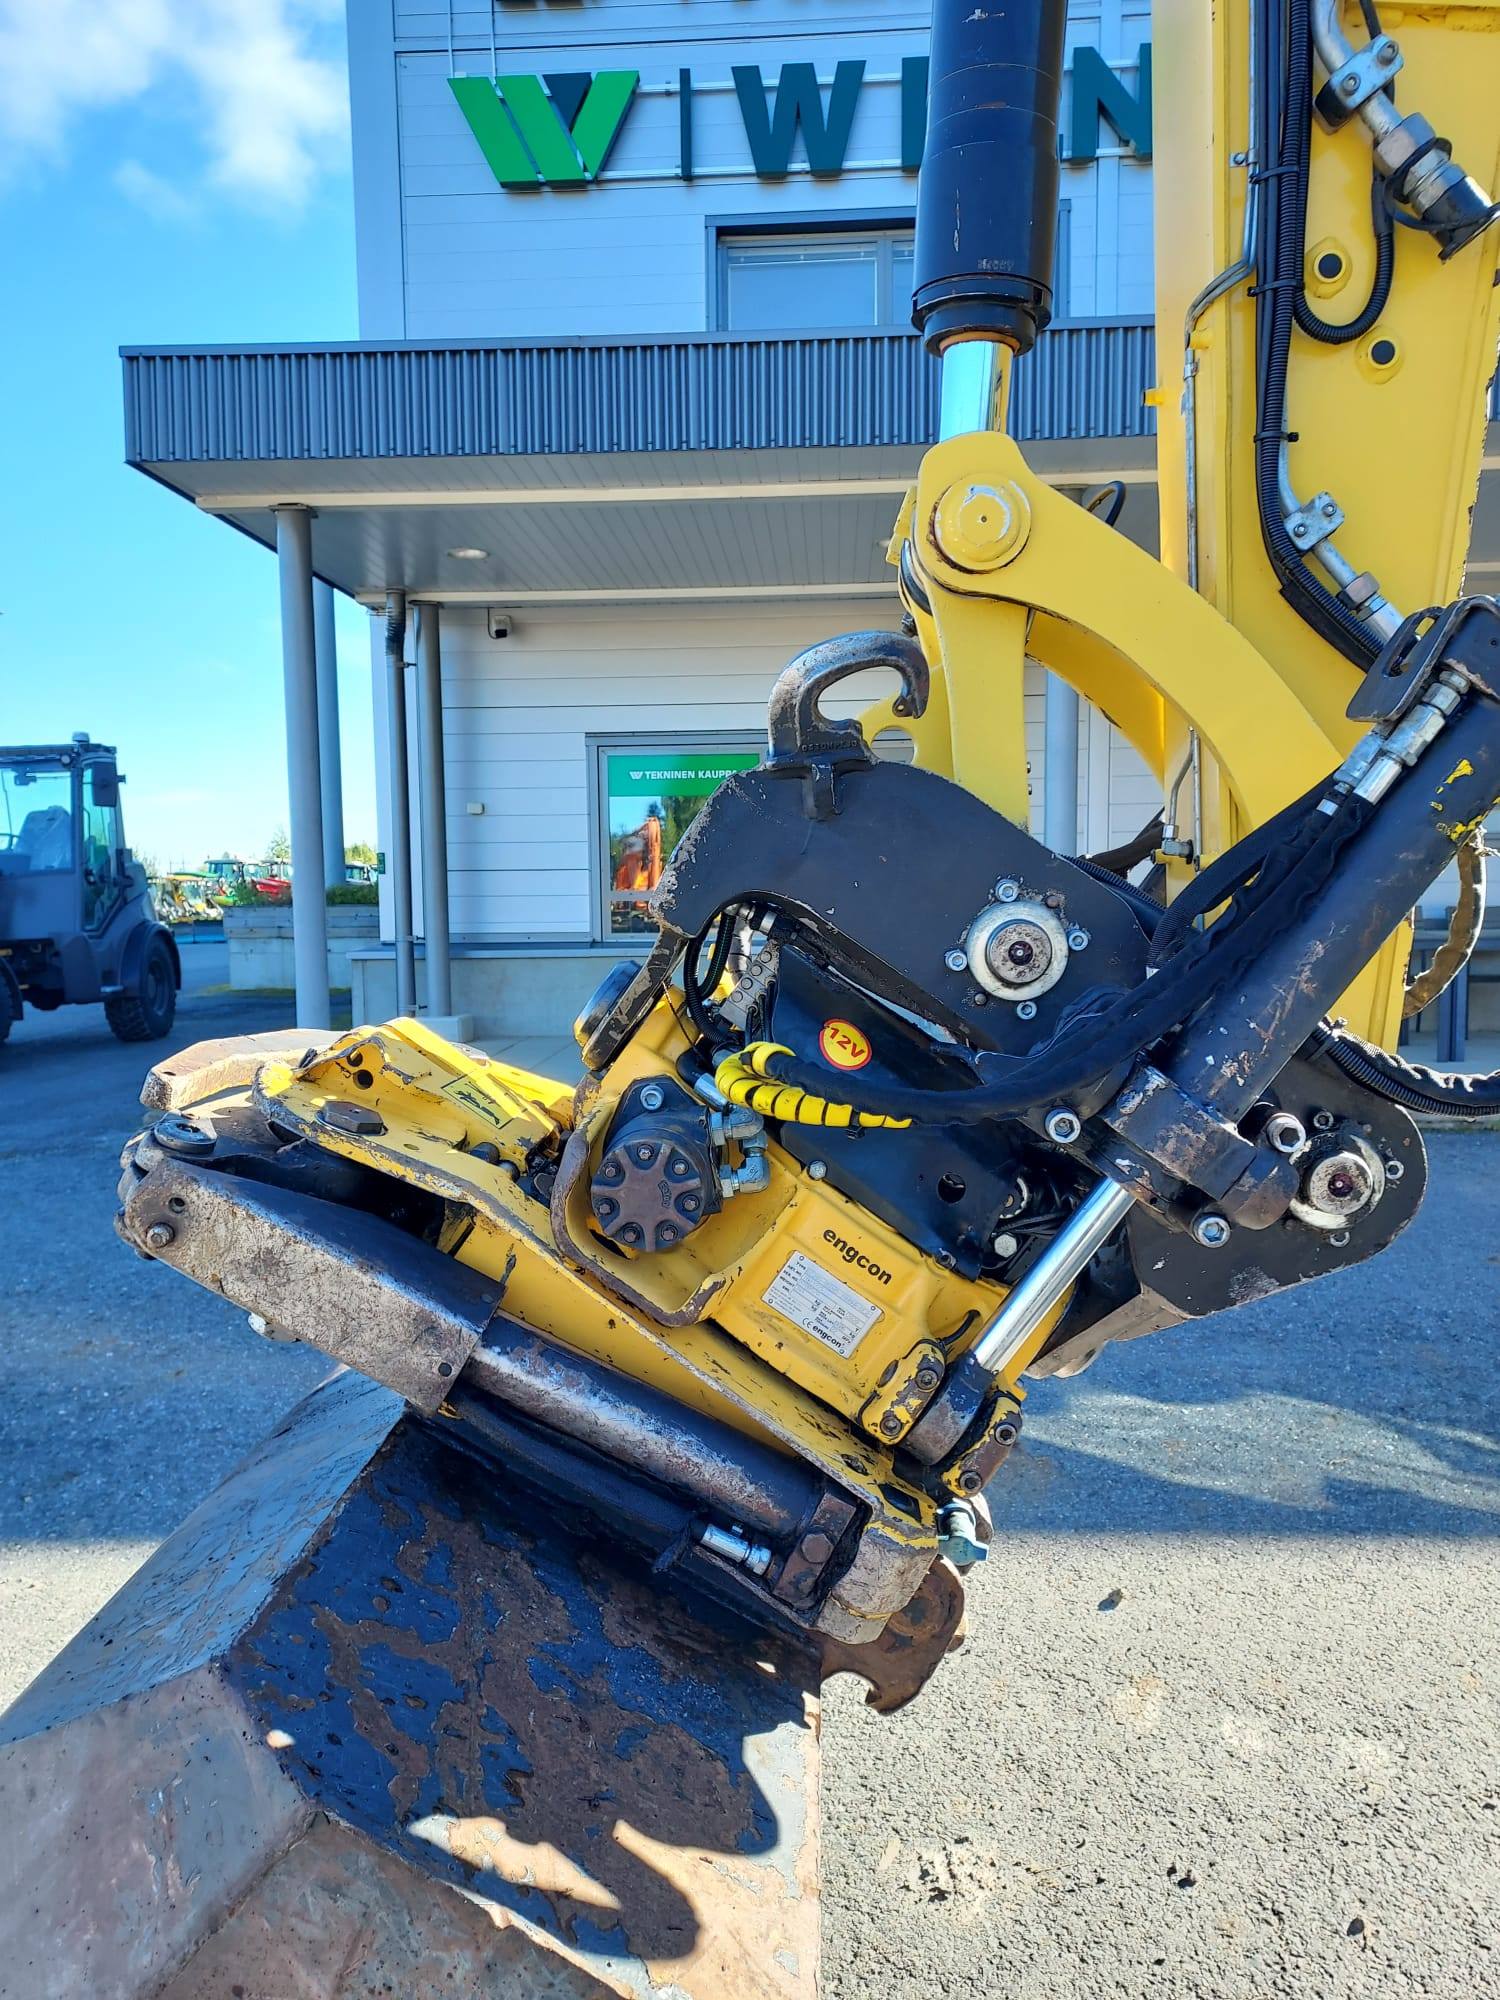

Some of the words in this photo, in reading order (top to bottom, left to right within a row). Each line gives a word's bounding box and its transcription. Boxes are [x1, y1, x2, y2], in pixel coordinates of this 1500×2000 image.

[644, 771, 696, 780] TEKNINEN
[830, 1027, 865, 1058] 12V
[823, 1229, 893, 1286] engcon
[812, 1325, 842, 1348] engcon
